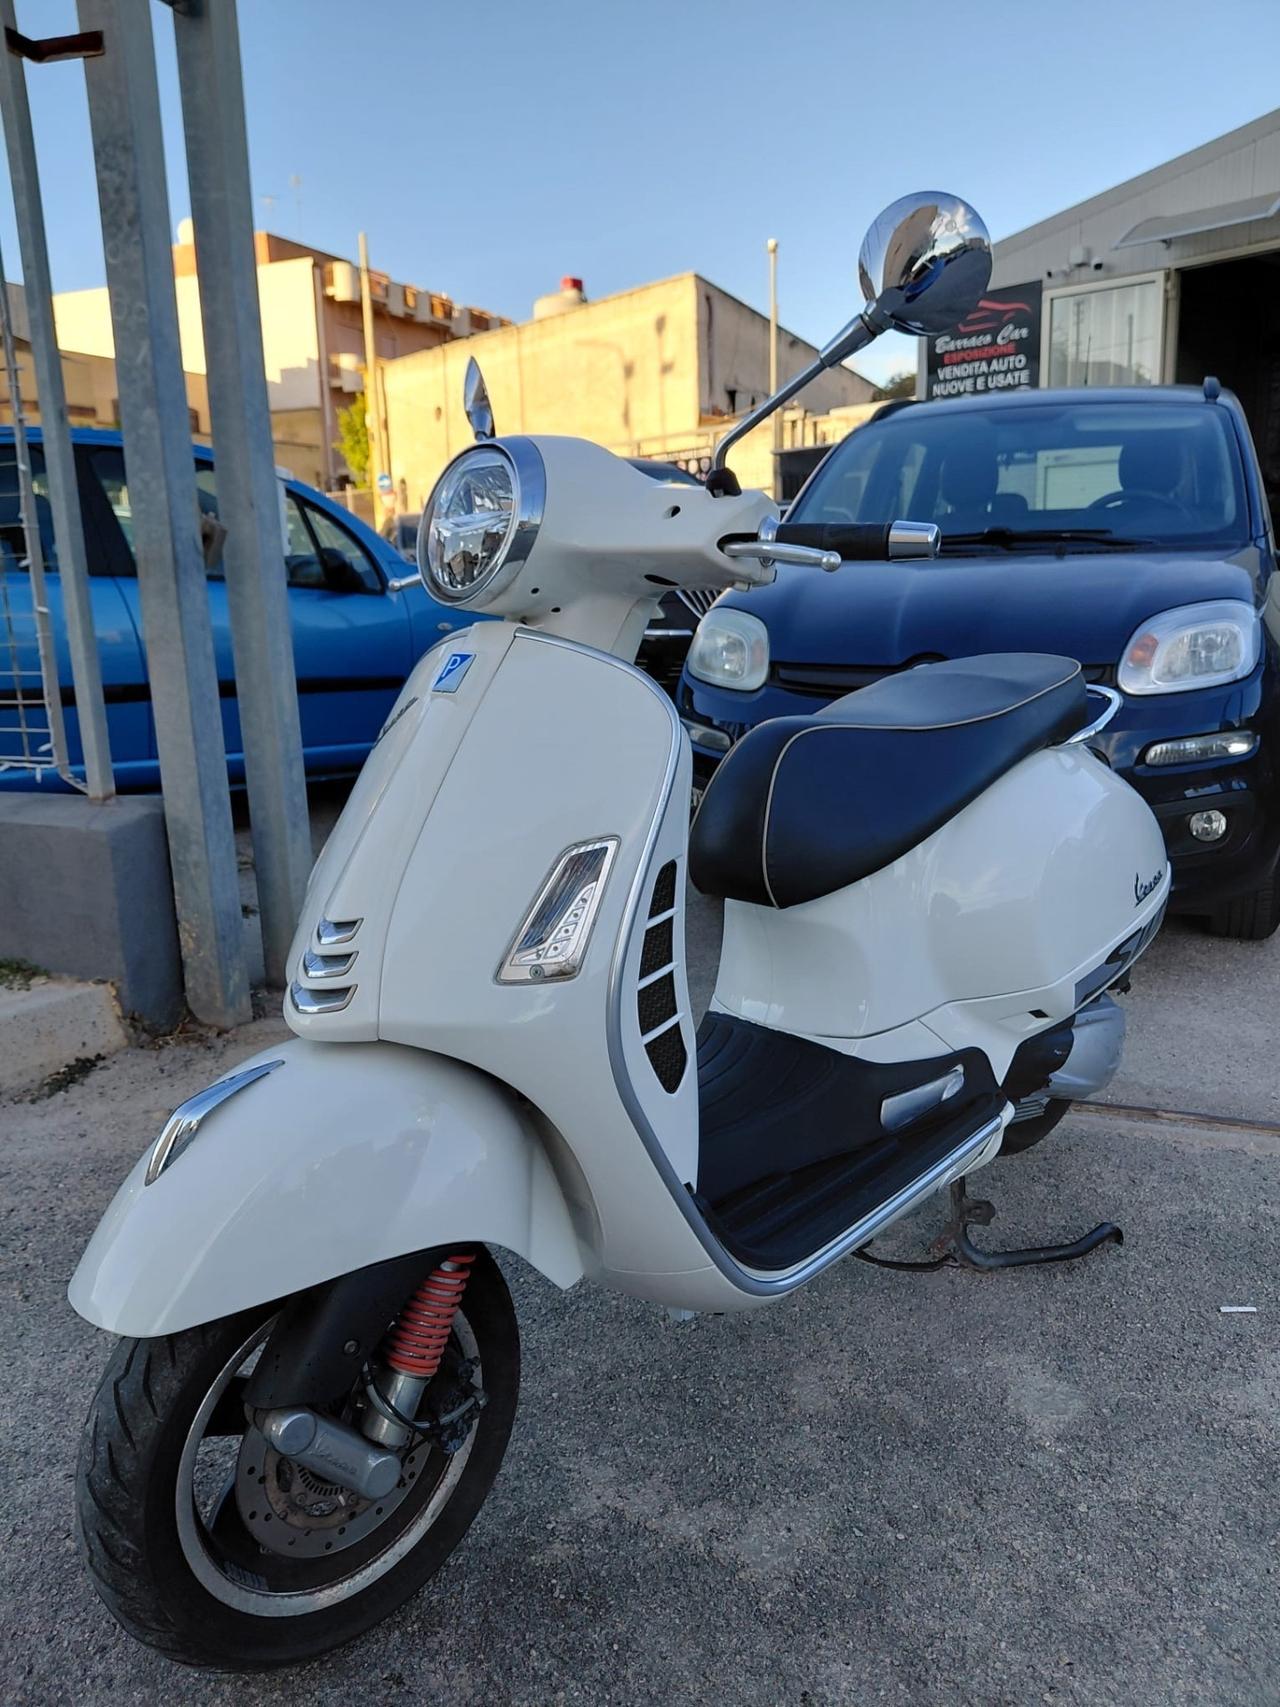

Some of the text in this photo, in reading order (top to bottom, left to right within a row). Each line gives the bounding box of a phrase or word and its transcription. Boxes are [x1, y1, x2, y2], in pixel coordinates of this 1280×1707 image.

[996, 323, 1029, 345] Car
[937, 354, 1027, 380] VENDITA AUTO
[932, 369, 1030, 397] NUOVE E USATE
